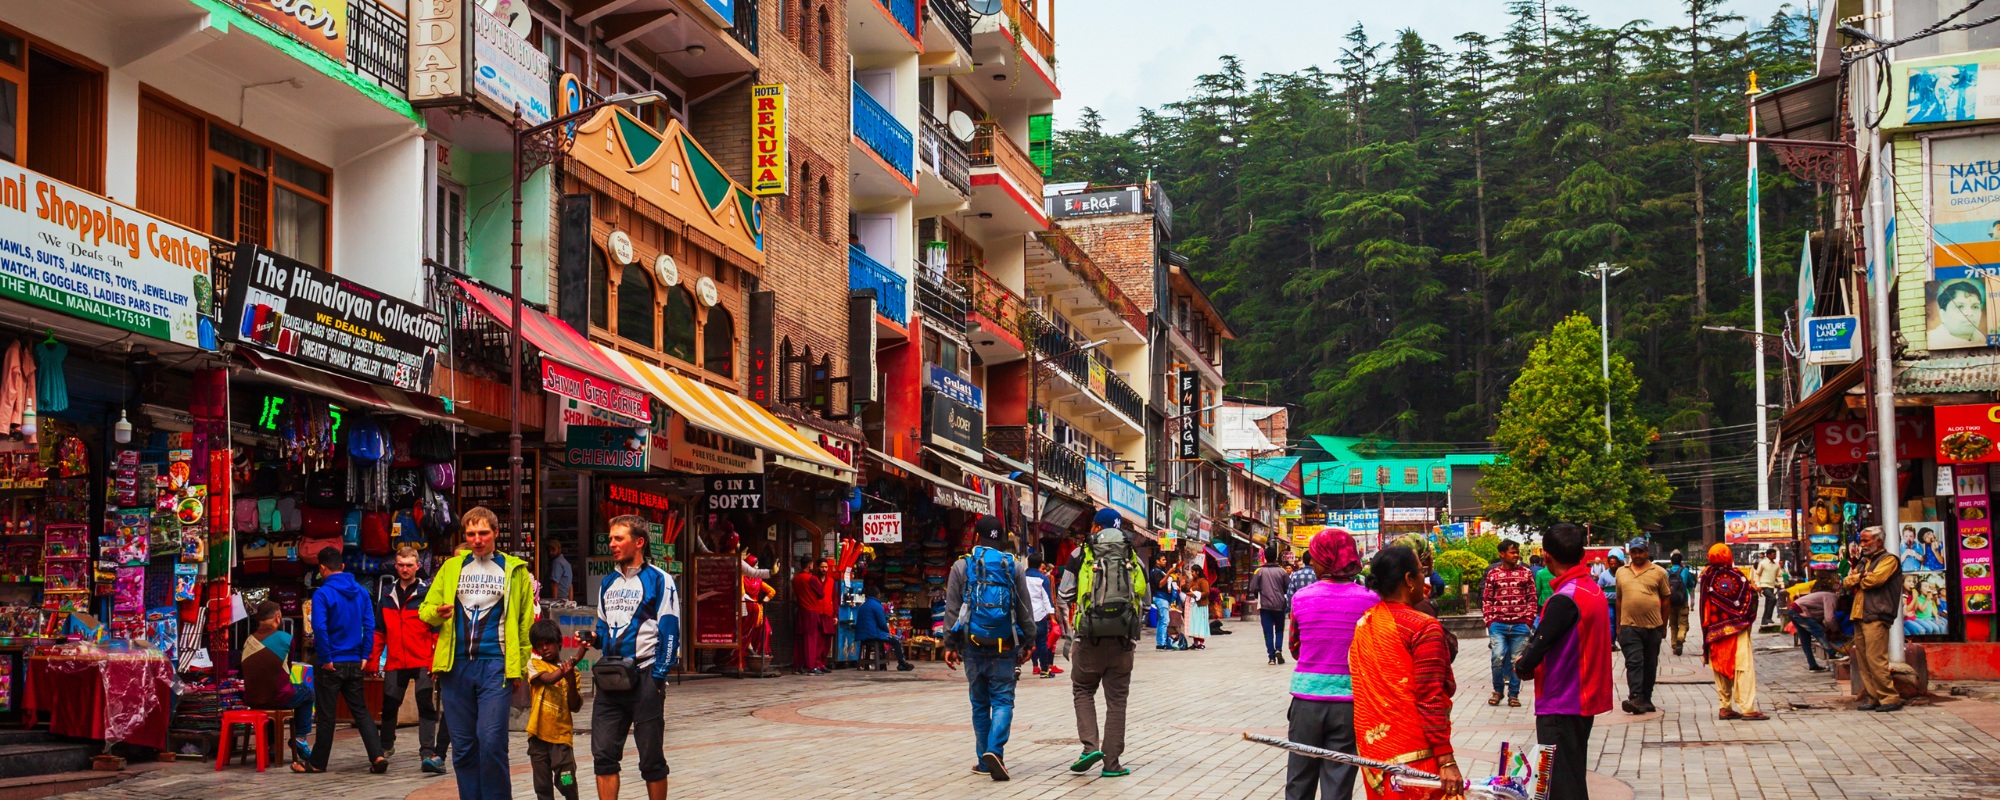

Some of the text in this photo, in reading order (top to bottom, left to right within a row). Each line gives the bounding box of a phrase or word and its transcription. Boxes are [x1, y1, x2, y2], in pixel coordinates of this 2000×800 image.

[517, 40, 549, 84] HOUSE
[754, 87, 781, 97] HOTEL
[530, 96, 549, 120] DELL
[757, 97, 778, 182] RENUKA
[0, 173, 210, 275] ni Shopping Center
[38, 231, 124, 269] We Deals In
[1, 257, 172, 319] WATCH, GOGGLES, LADIES PARS ETC.
[36, 250, 67, 273] SUITS,
[70, 261, 114, 287] JACKETS,
[115, 275, 141, 295] TOYS,
[142, 283, 189, 307] JEWELLERY
[1, 274, 151, 329] THE MALL MANALI-175131
[256, 252, 442, 345] The Himalayan Collection
[316, 312, 333, 327] WE
[334, 318, 368, 338] DEALS
[1816, 322, 1846, 330] NATURE
[1816, 330, 1838, 338] LAND
[282, 312, 312, 336] TRAVELLING
[311, 321, 325, 339] BAGS
[337, 330, 352, 347] ITEMS
[400, 349, 422, 368] GARMENTS
[548, 364, 580, 398] SHIVAM
[584, 378, 608, 408] GIFTS
[610, 388, 643, 416] CORNER
[943, 376, 972, 396] Gulati
[563, 408, 585, 426] SHRI
[650, 434, 669, 451] TORE
[1825, 420, 1925, 446] SOTY
[568, 448, 644, 468] CHEMIST
[692, 448, 706, 460] PURE
[717, 455, 747, 469] RESTAURANT
[1850, 446, 1862, 459] 6
[696, 462, 711, 473] SOUTH
[713, 479, 755, 490] 6 IN 1
[709, 494, 761, 510] SOFTY
[1328, 511, 1379, 521] Harisons
[1348, 520, 1379, 530] Travels
[864, 520, 901, 536] SOFTY
[588, 561, 618, 576] PHARM
